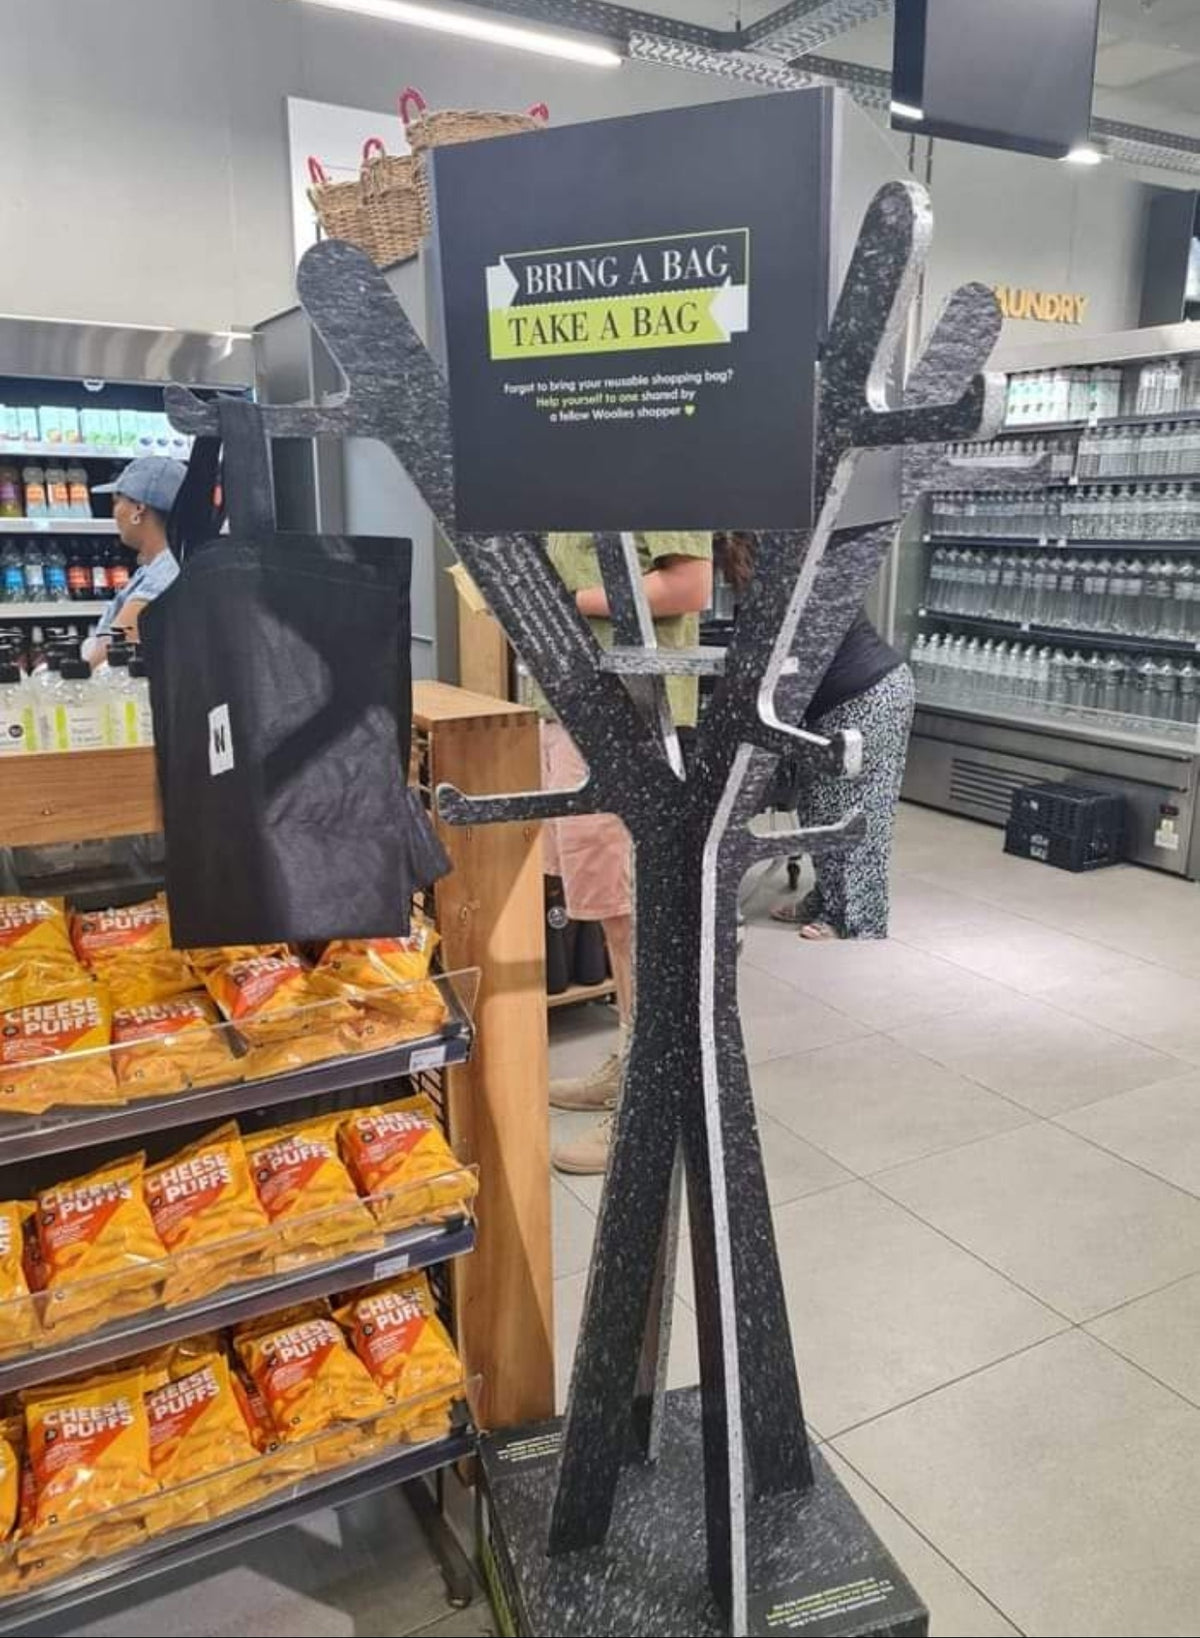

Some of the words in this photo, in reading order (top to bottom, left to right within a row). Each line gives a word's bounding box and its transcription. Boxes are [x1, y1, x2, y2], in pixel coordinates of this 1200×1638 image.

[526, 256, 618, 294] BRING
[629, 253, 651, 285] A
[662, 244, 729, 281] BAG
[994, 284, 1089, 323] AUNDRY
[508, 311, 589, 347] TAKE
[600, 310, 620, 340] A
[632, 302, 699, 338] BAG
[503, 383, 535, 396] Forgot
[537, 382, 548, 392] to
[549, 380, 576, 393] bring
[578, 379, 601, 391] your
[604, 374, 649, 388] reusable
[652, 372, 702, 385] shopping
[704, 367, 734, 384] bag?
[536, 396, 560, 408] Help
[561, 393, 603, 408] yourself
[605, 393, 616, 403] to
[619, 393, 639, 403] one
[641, 387, 678, 401] shared
[680, 387, 697, 401] by
[550, 413, 558, 422] a
[559, 409, 589, 421] fellow
[591, 406, 635, 420] Woolies
[637, 405, 681, 419] shopper
[4, 997, 98, 1023] CHEESE
[24, 1013, 102, 1036] PUFFS
[270, 1143, 332, 1171] PUFFS
[146, 1154, 230, 1192] CHEESE
[165, 1168, 232, 1202] PUFFS
[60, 1187, 132, 1219] PUFFS
[150, 1367, 217, 1406] HEESE
[155, 1381, 220, 1420] PUFFS
[43, 1398, 131, 1425] CHEESE
[62, 1411, 134, 1439] PUFFS
